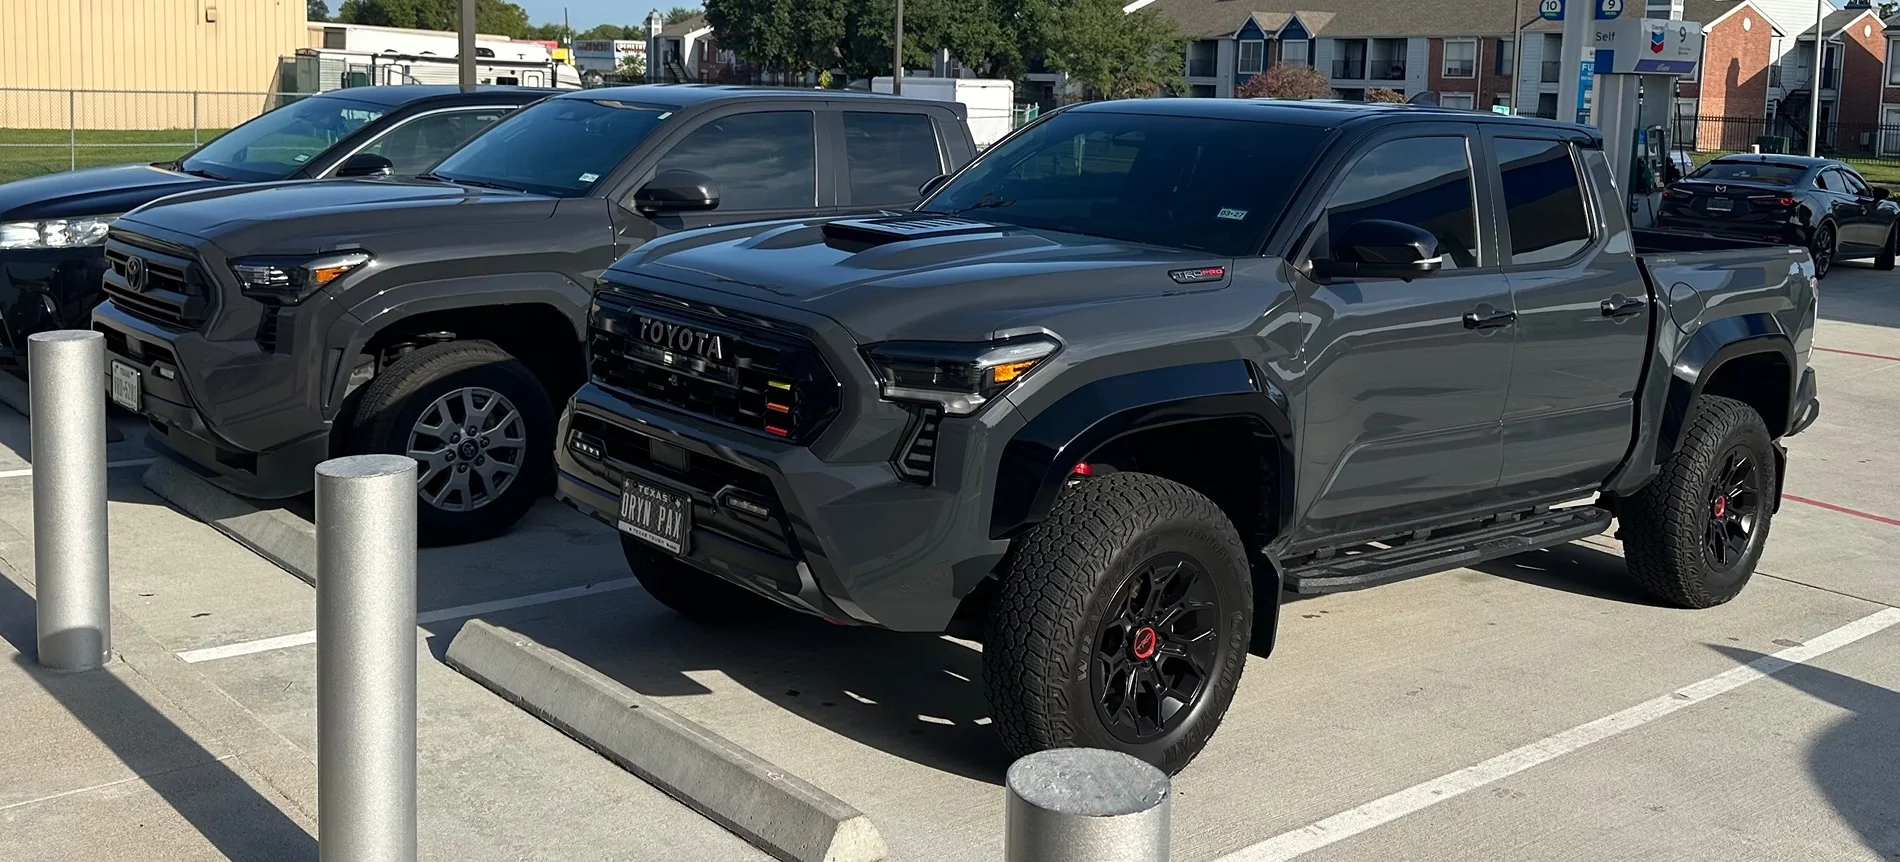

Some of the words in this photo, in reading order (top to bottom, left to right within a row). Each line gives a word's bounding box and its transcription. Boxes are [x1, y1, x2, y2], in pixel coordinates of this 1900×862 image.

[1545, 0, 1558, 11] 10
[1608, 0, 1616, 10] 9
[1595, 31, 1616, 42] Self
[1679, 26, 1687, 43] 9
[639, 317, 723, 360] TOYOTA
[639, 485, 667, 502] TEXAS
[657, 506, 681, 540] PAX
[1163, 610, 1245, 766] GOODYEAR
